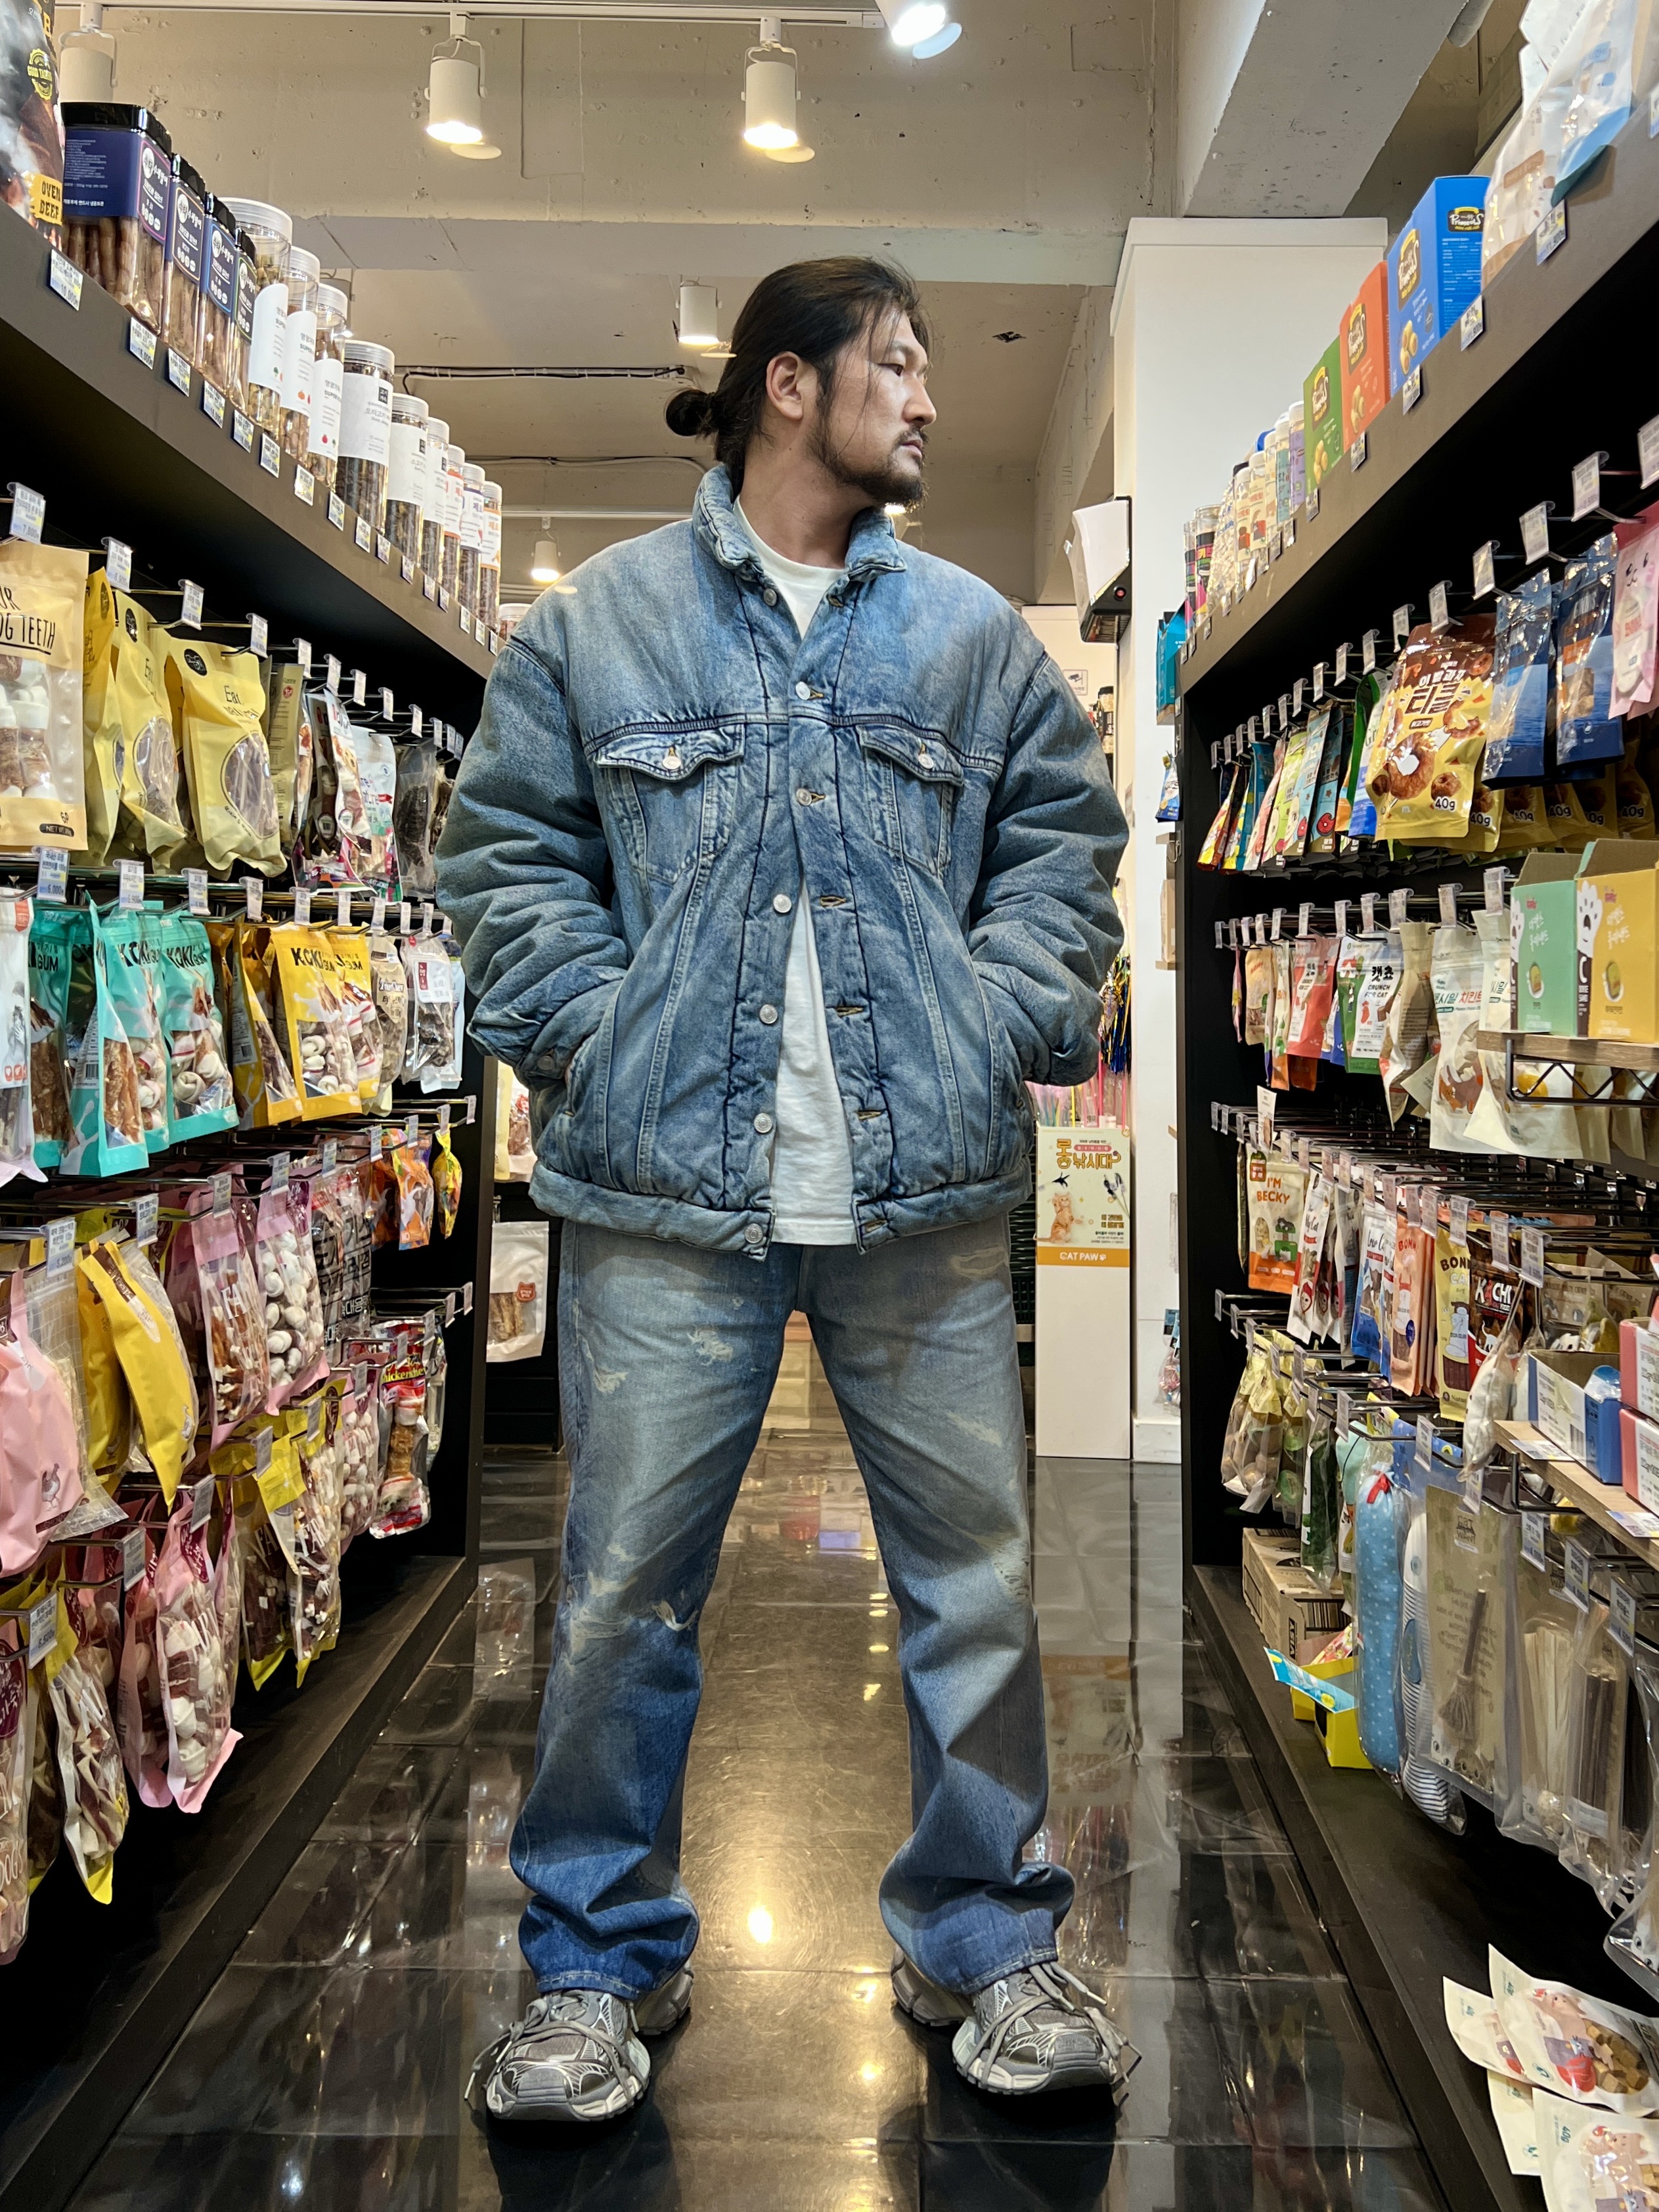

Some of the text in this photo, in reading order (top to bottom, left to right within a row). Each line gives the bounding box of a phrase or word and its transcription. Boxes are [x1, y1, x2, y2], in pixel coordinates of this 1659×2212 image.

[41, 181, 60, 202] OVEN
[39, 199, 59, 219] BEEF
[21, 613, 56, 650] TEETH
[223, 685, 241, 705] Eat
[1434, 796, 1455, 811] 40g
[1549, 804, 1572, 818] 40g
[1622, 804, 1644, 818] 40g
[1470, 813, 1491, 828] 40g
[38, 956, 58, 972] GUM
[1056, 1139, 1072, 1170] 롱
[1268, 1177, 1281, 1189] I'M
[1256, 1191, 1290, 1205] BECKY
[1059, 1252, 1099, 1261] CAT PAW
